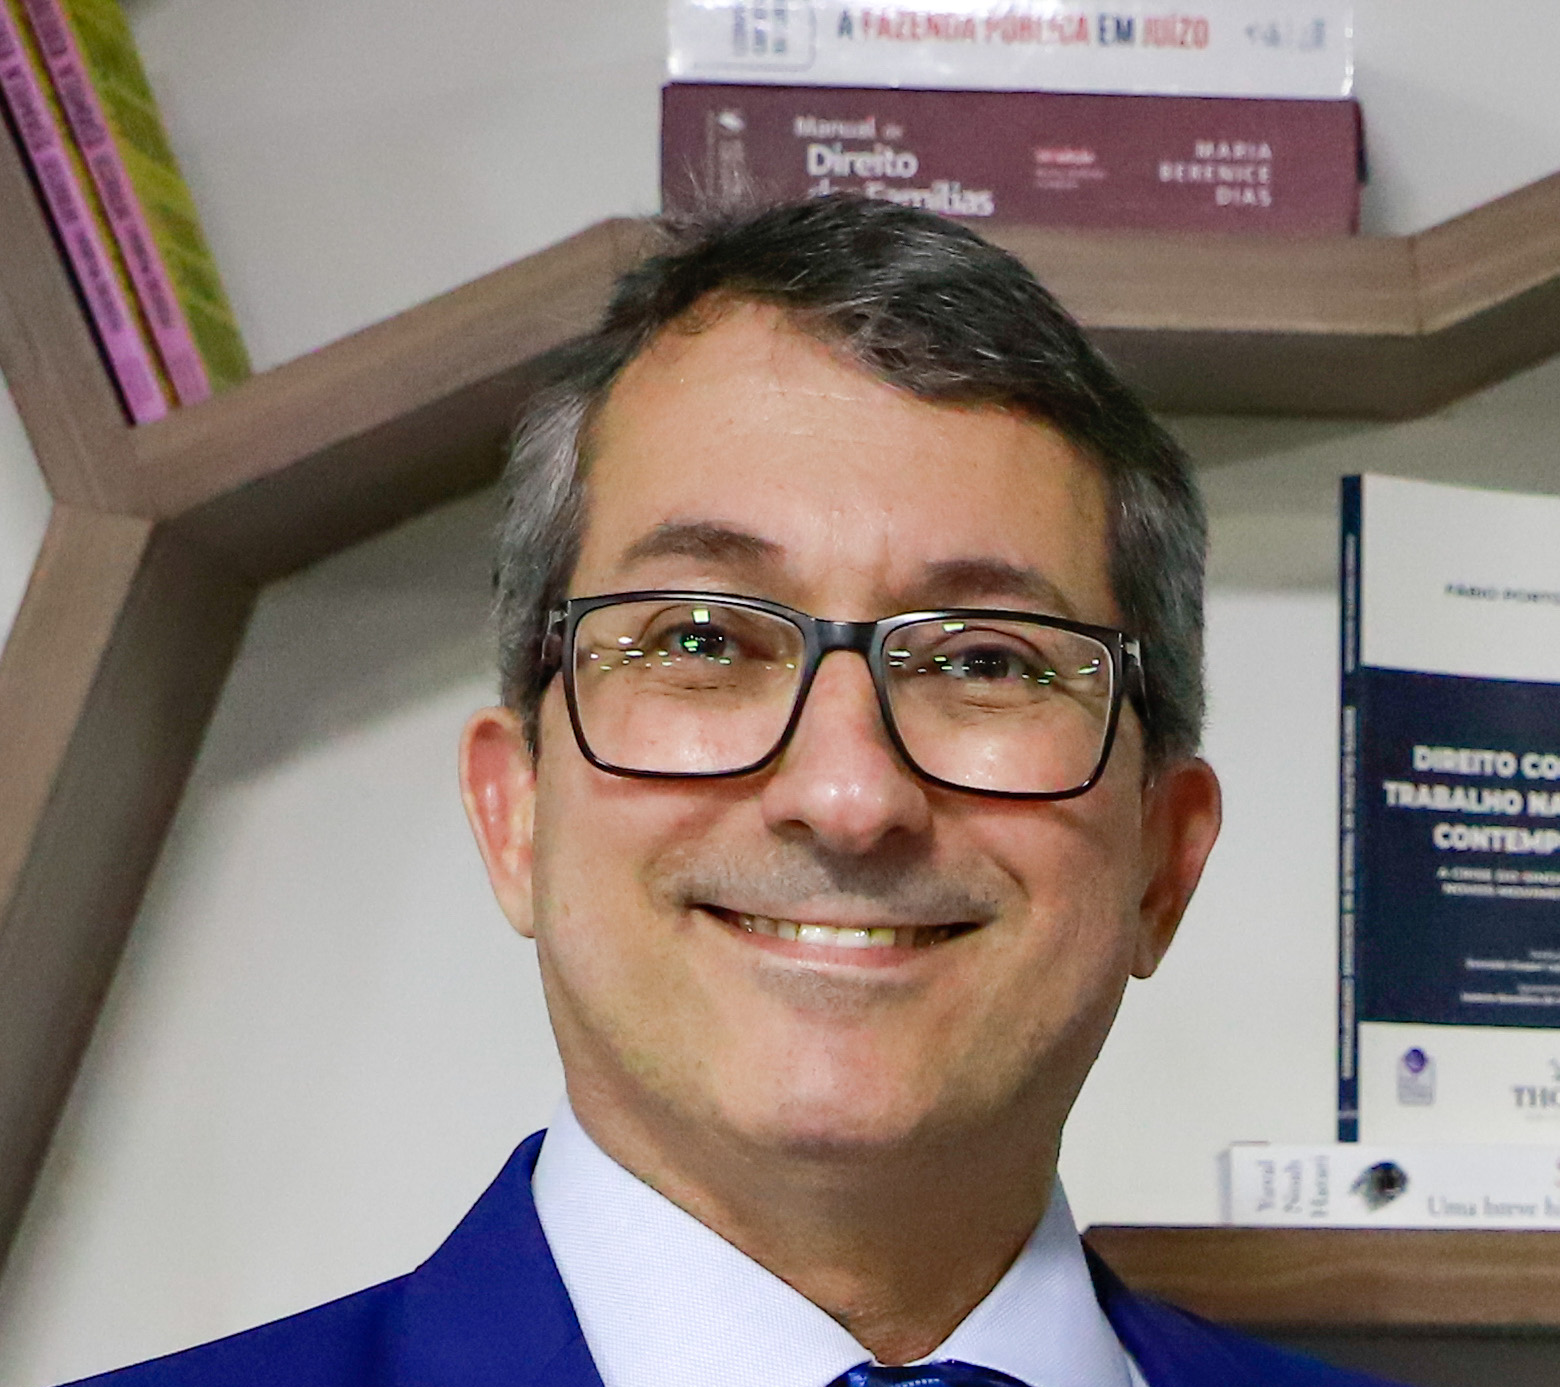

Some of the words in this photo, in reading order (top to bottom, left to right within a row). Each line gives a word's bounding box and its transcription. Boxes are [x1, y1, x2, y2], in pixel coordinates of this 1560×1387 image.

[1097, 12, 1135, 46] EM
[806, 142, 920, 178] Direito
[1195, 139, 1272, 160] MARIA
[1158, 160, 1272, 183] BERENICE
[1215, 185, 1272, 207] DIAS
[1412, 745, 1517, 779] DIREITO
[1383, 780, 1524, 816] TRABALHO
[1428, 1194, 1477, 1217] Uma
[1483, 1194, 1537, 1216] breve
